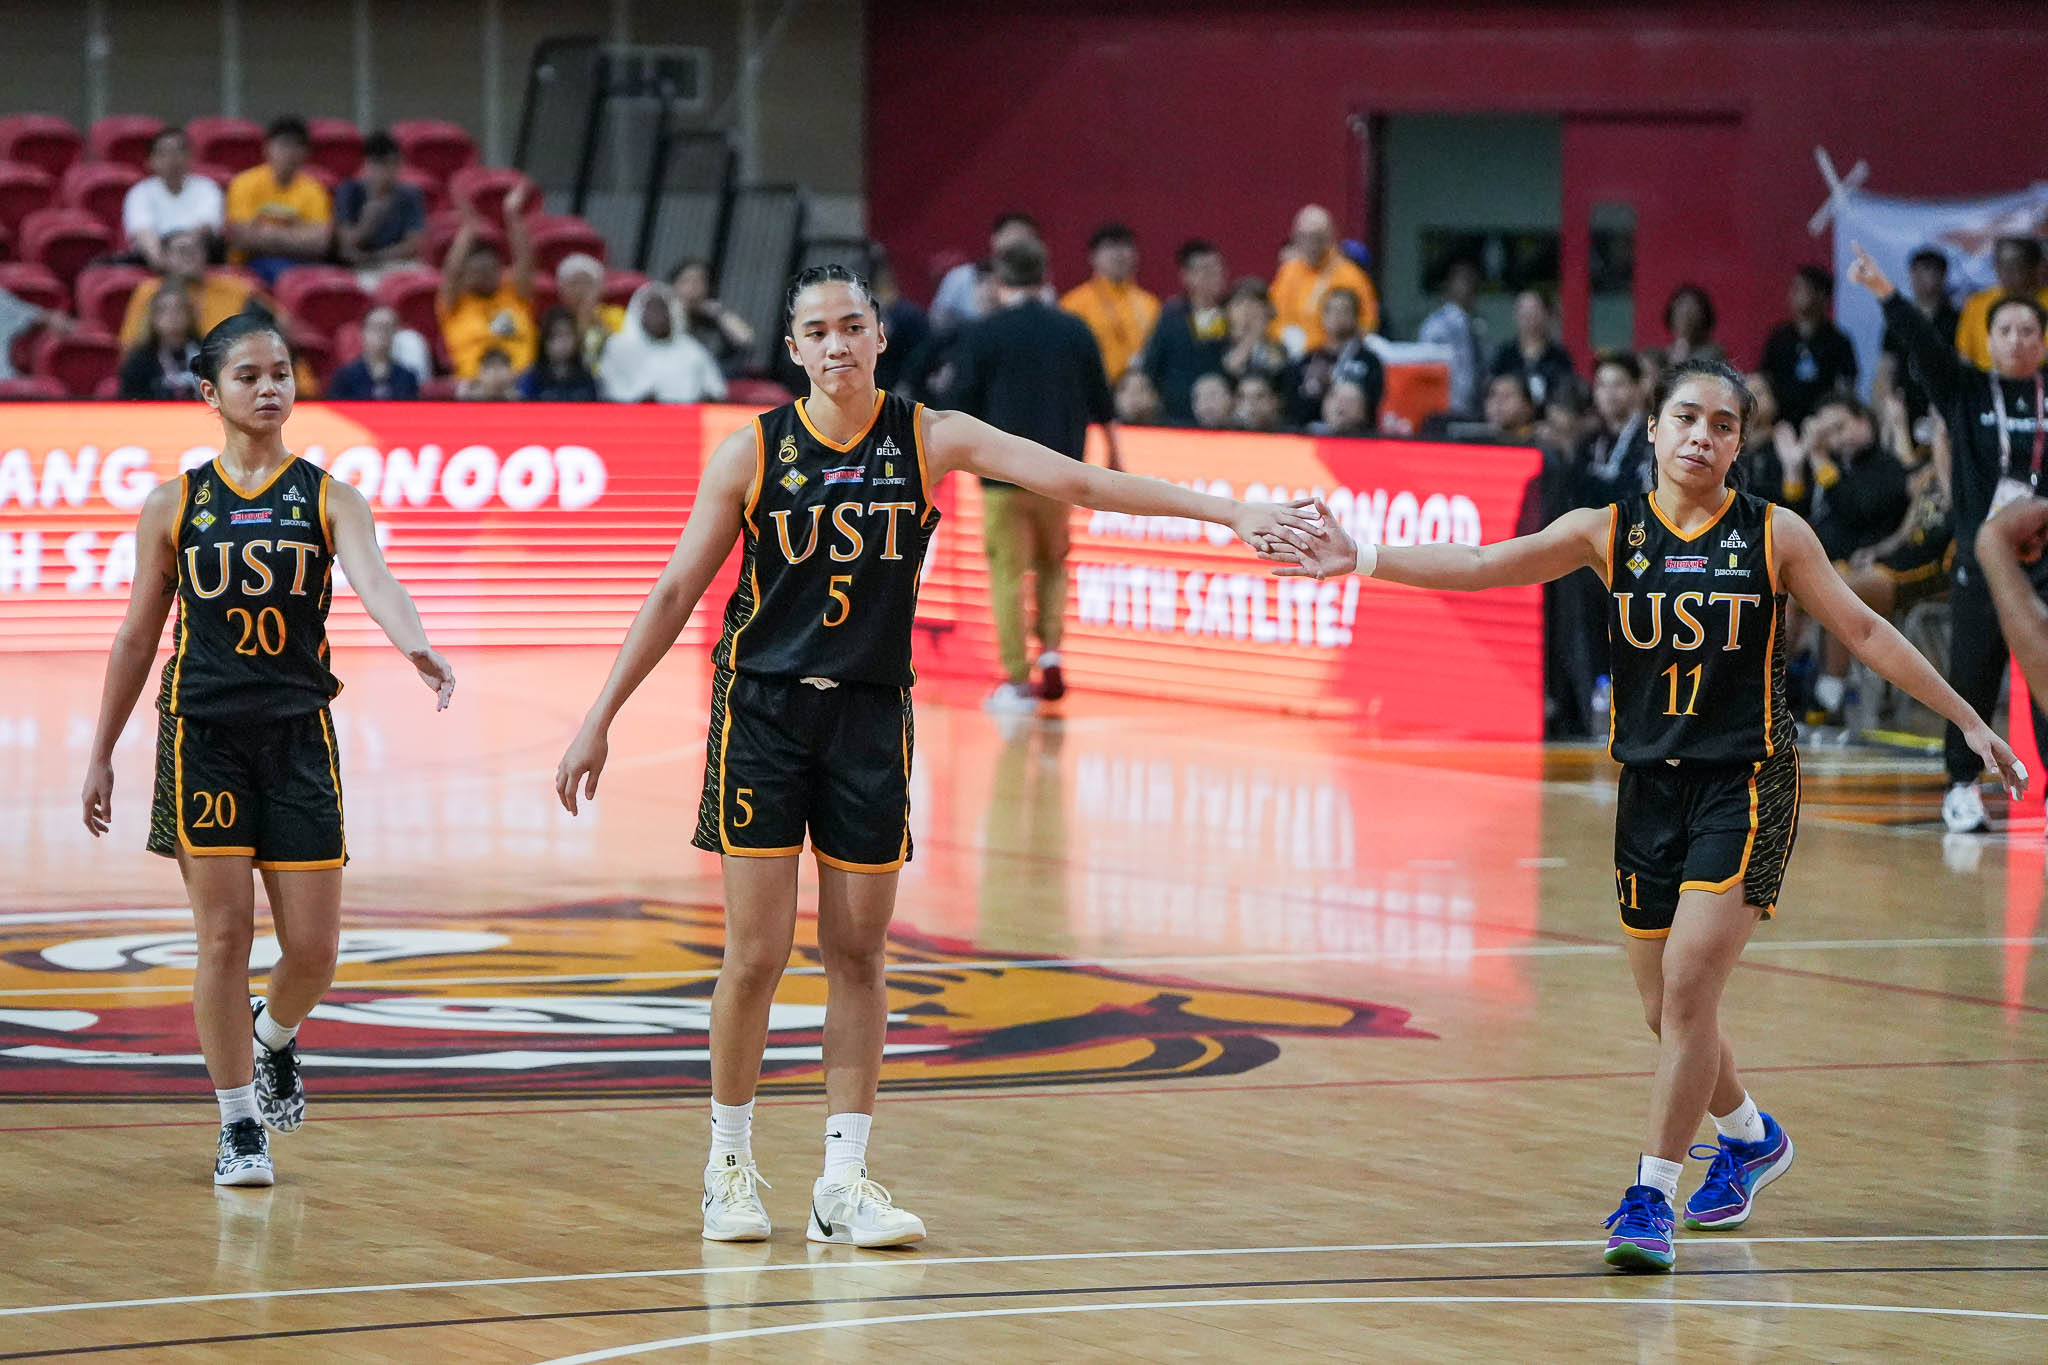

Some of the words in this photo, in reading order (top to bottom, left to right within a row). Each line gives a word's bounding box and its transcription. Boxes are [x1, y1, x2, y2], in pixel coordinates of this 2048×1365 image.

[876, 447, 902, 456] DELTA
[282, 494, 306, 504] DELTA
[768, 502, 916, 565] UST
[1720, 540, 1748, 549] DELTA
[184, 540, 320, 599] UST
[1714, 568, 1752, 578] DISCOVERY
[823, 575, 852, 627] 5
[1077, 564, 1178, 632] WITH
[1613, 592, 1761, 651] UST
[226, 606, 287, 656] 20
[1661, 662, 1703, 716] 11
[192, 790, 237, 829] 20
[733, 787, 754, 828] 5
